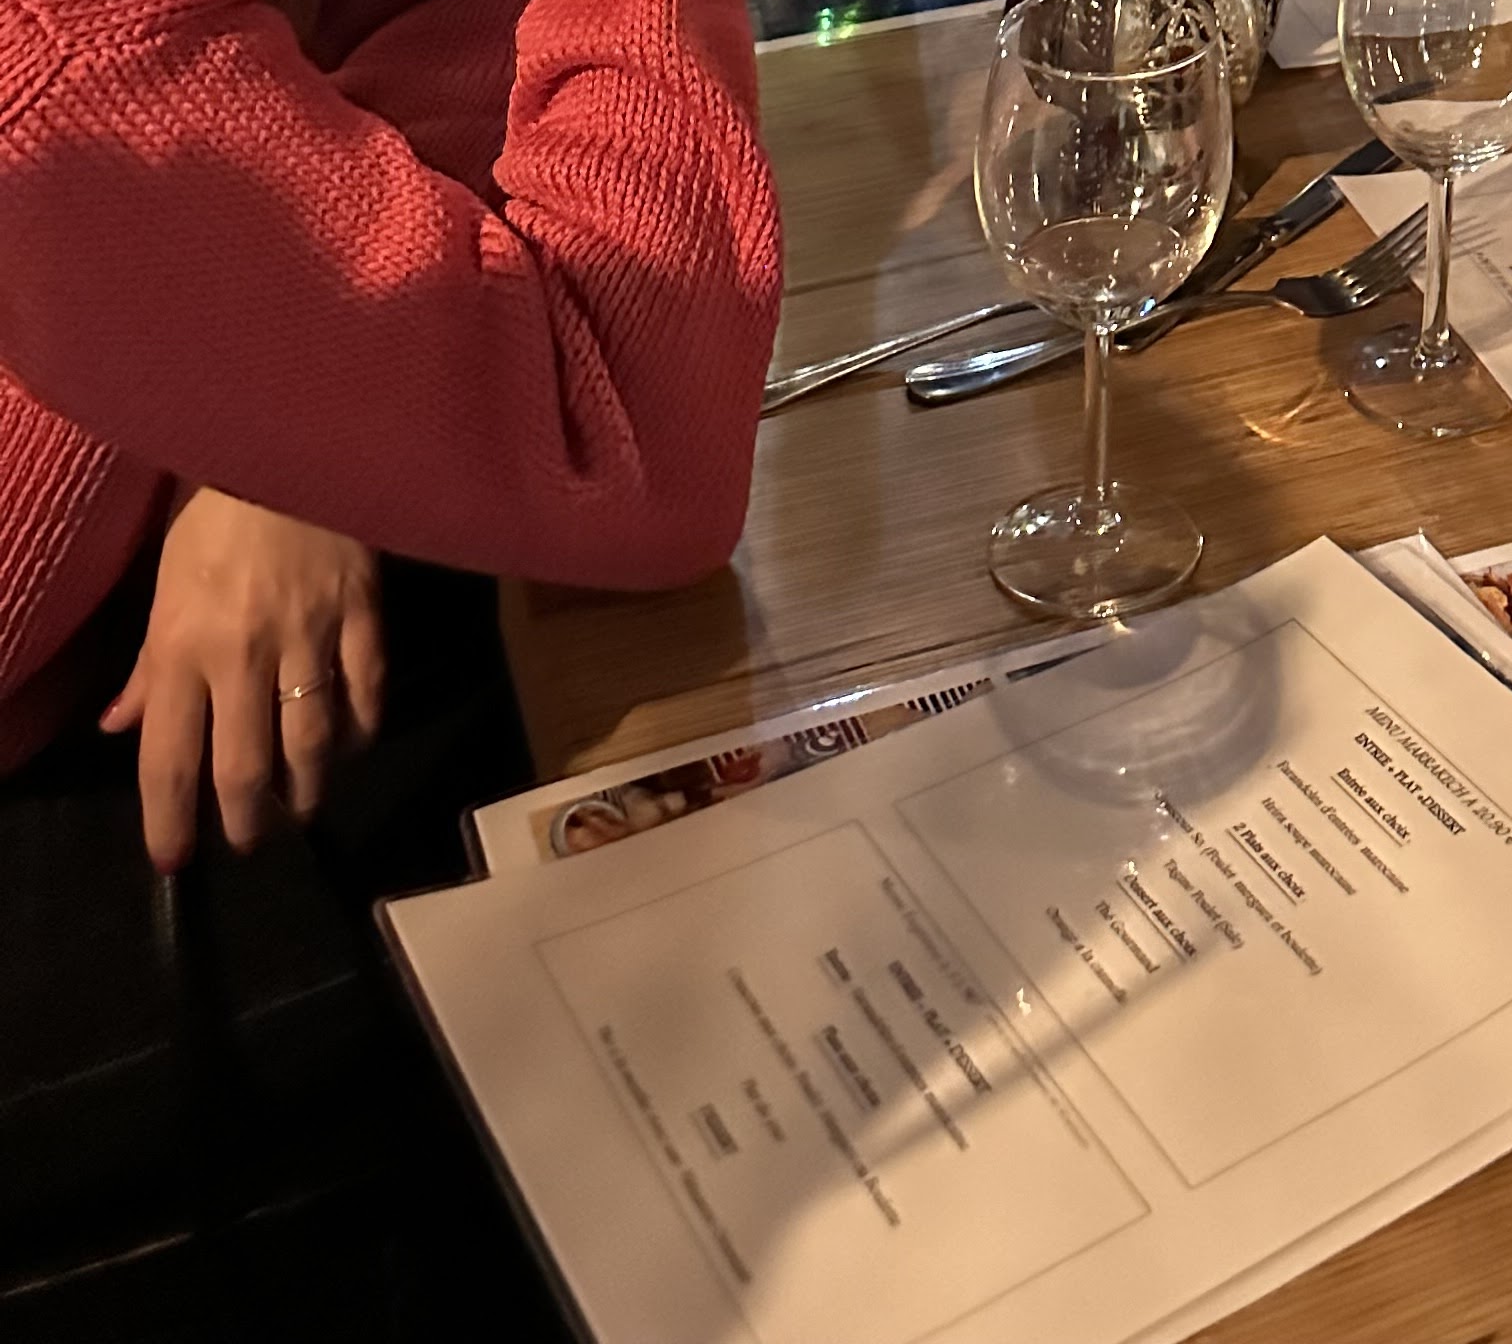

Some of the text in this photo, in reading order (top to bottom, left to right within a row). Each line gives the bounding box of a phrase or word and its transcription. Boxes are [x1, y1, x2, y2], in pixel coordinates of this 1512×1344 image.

[1364, 706, 1406, 737] MENU
[1396, 736, 1471, 798] MARRAKECH
[1276, 759, 1324, 807] Farandoles
[1336, 767, 1368, 797] Entrée
[1363, 796, 1385, 814] aux
[1393, 769, 1423, 794] PLAT
[1239, 829, 1264, 853] Plats
[1259, 852, 1281, 872] aux
[1151, 909, 1174, 929] aux
